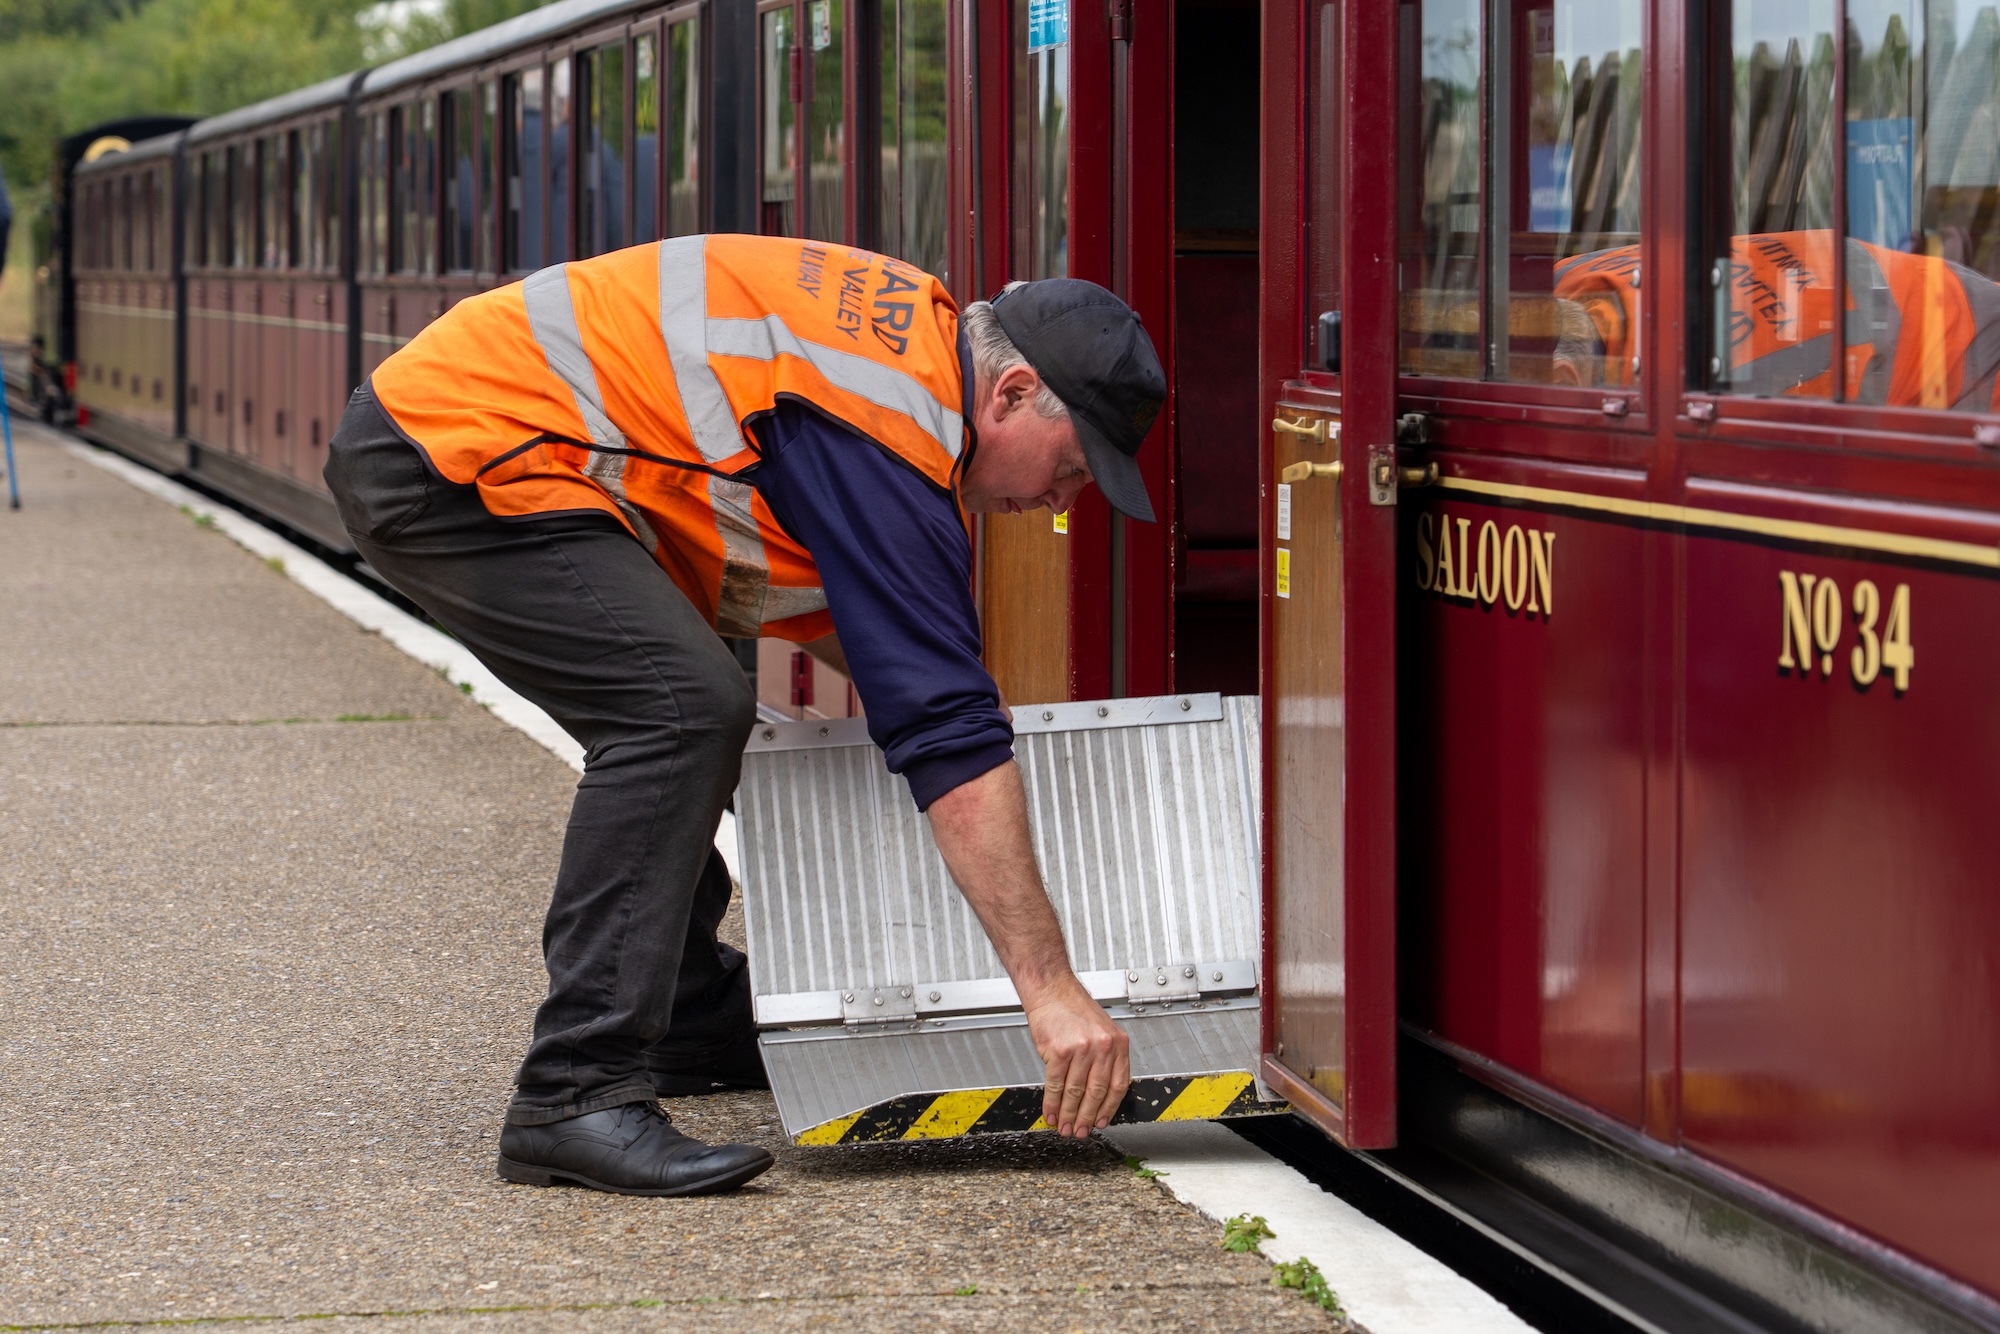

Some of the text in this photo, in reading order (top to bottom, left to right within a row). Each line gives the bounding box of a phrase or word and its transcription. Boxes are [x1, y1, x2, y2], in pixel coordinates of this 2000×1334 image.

[836, 267, 869, 341] VALLEY
[872, 258, 924, 355] UARD
[1416, 511, 1556, 617] SALOON
[1851, 580, 1914, 691] 34
